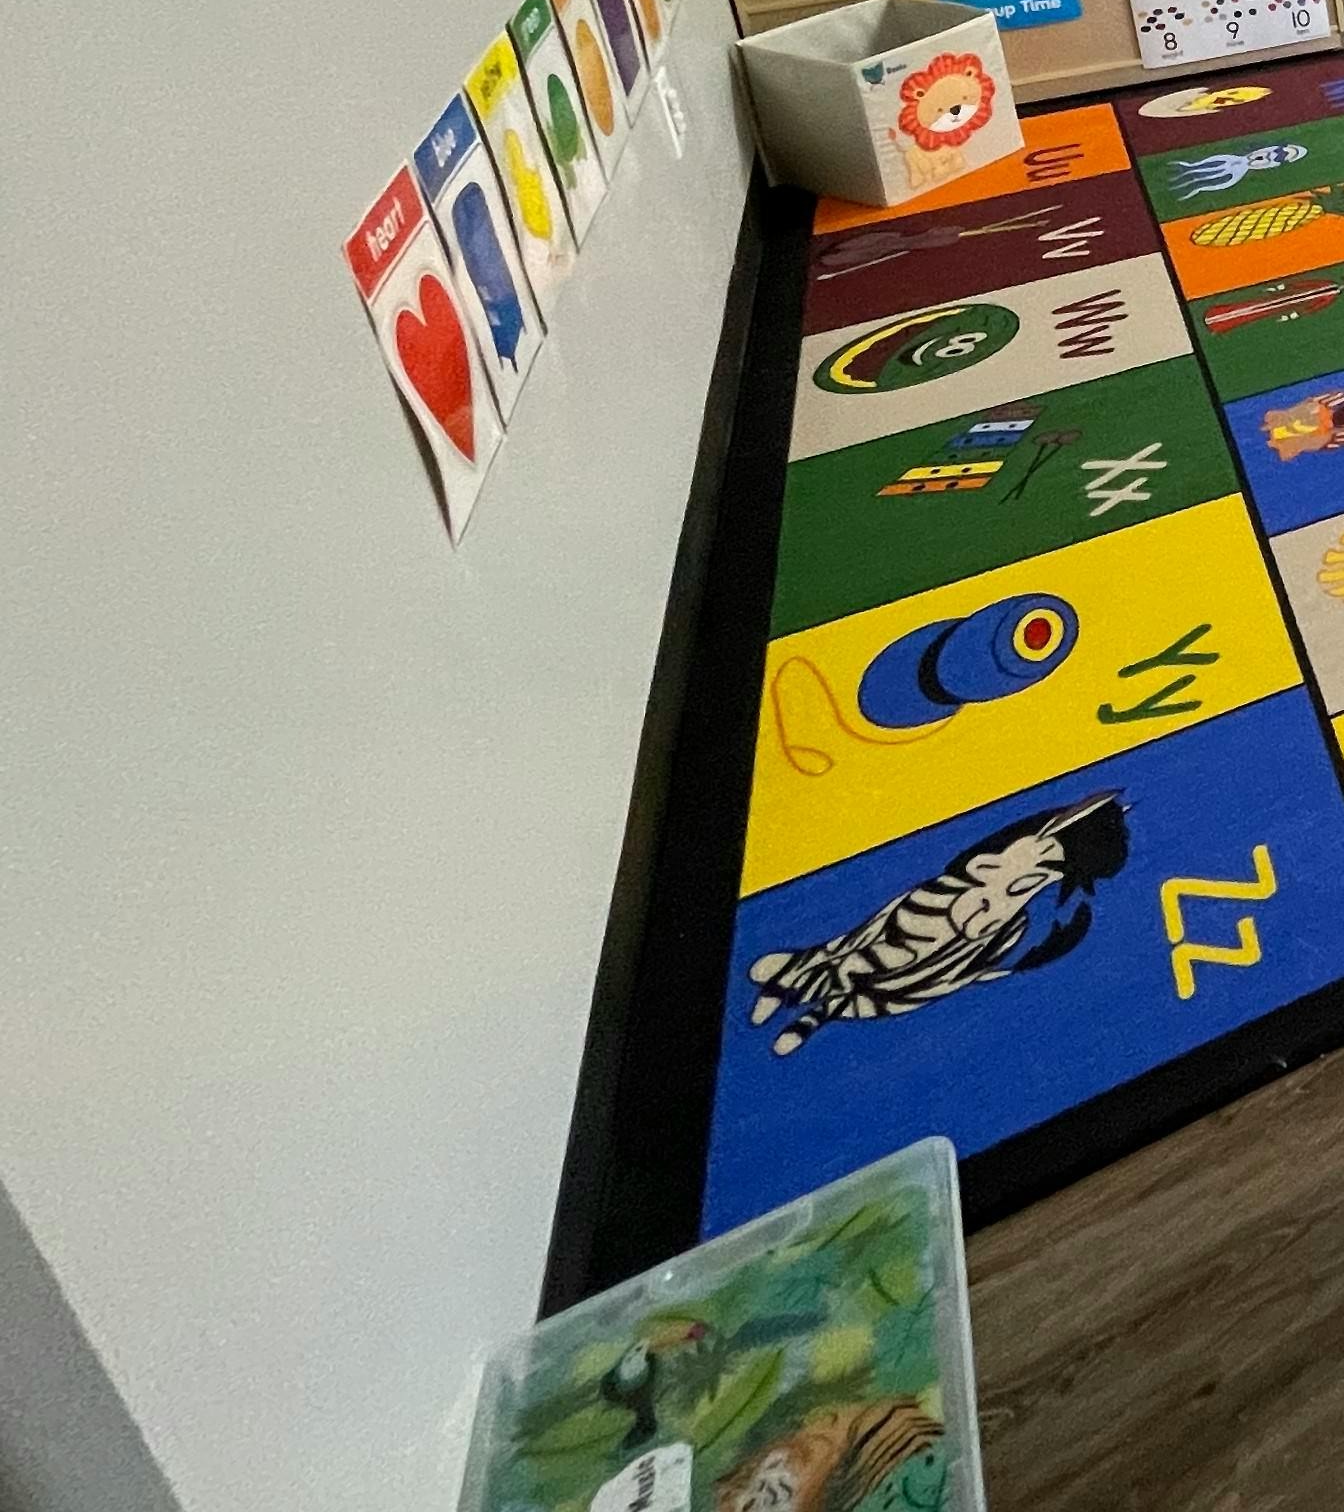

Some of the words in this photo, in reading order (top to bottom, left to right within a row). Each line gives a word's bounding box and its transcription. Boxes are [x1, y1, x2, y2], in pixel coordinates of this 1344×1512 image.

[1163, 31, 1178, 52] 8
[1225, 21, 1240, 40] 9
[1291, 8, 1312, 29] 10
[1023, 143, 1085, 184] Uu
[1037, 215, 1105, 261] Vv
[1051, 287, 1131, 361] Ww
[1080, 440, 1169, 519] Xx
[1096, 622, 1221, 725] Yy
[1160, 843, 1278, 1001] Zz
